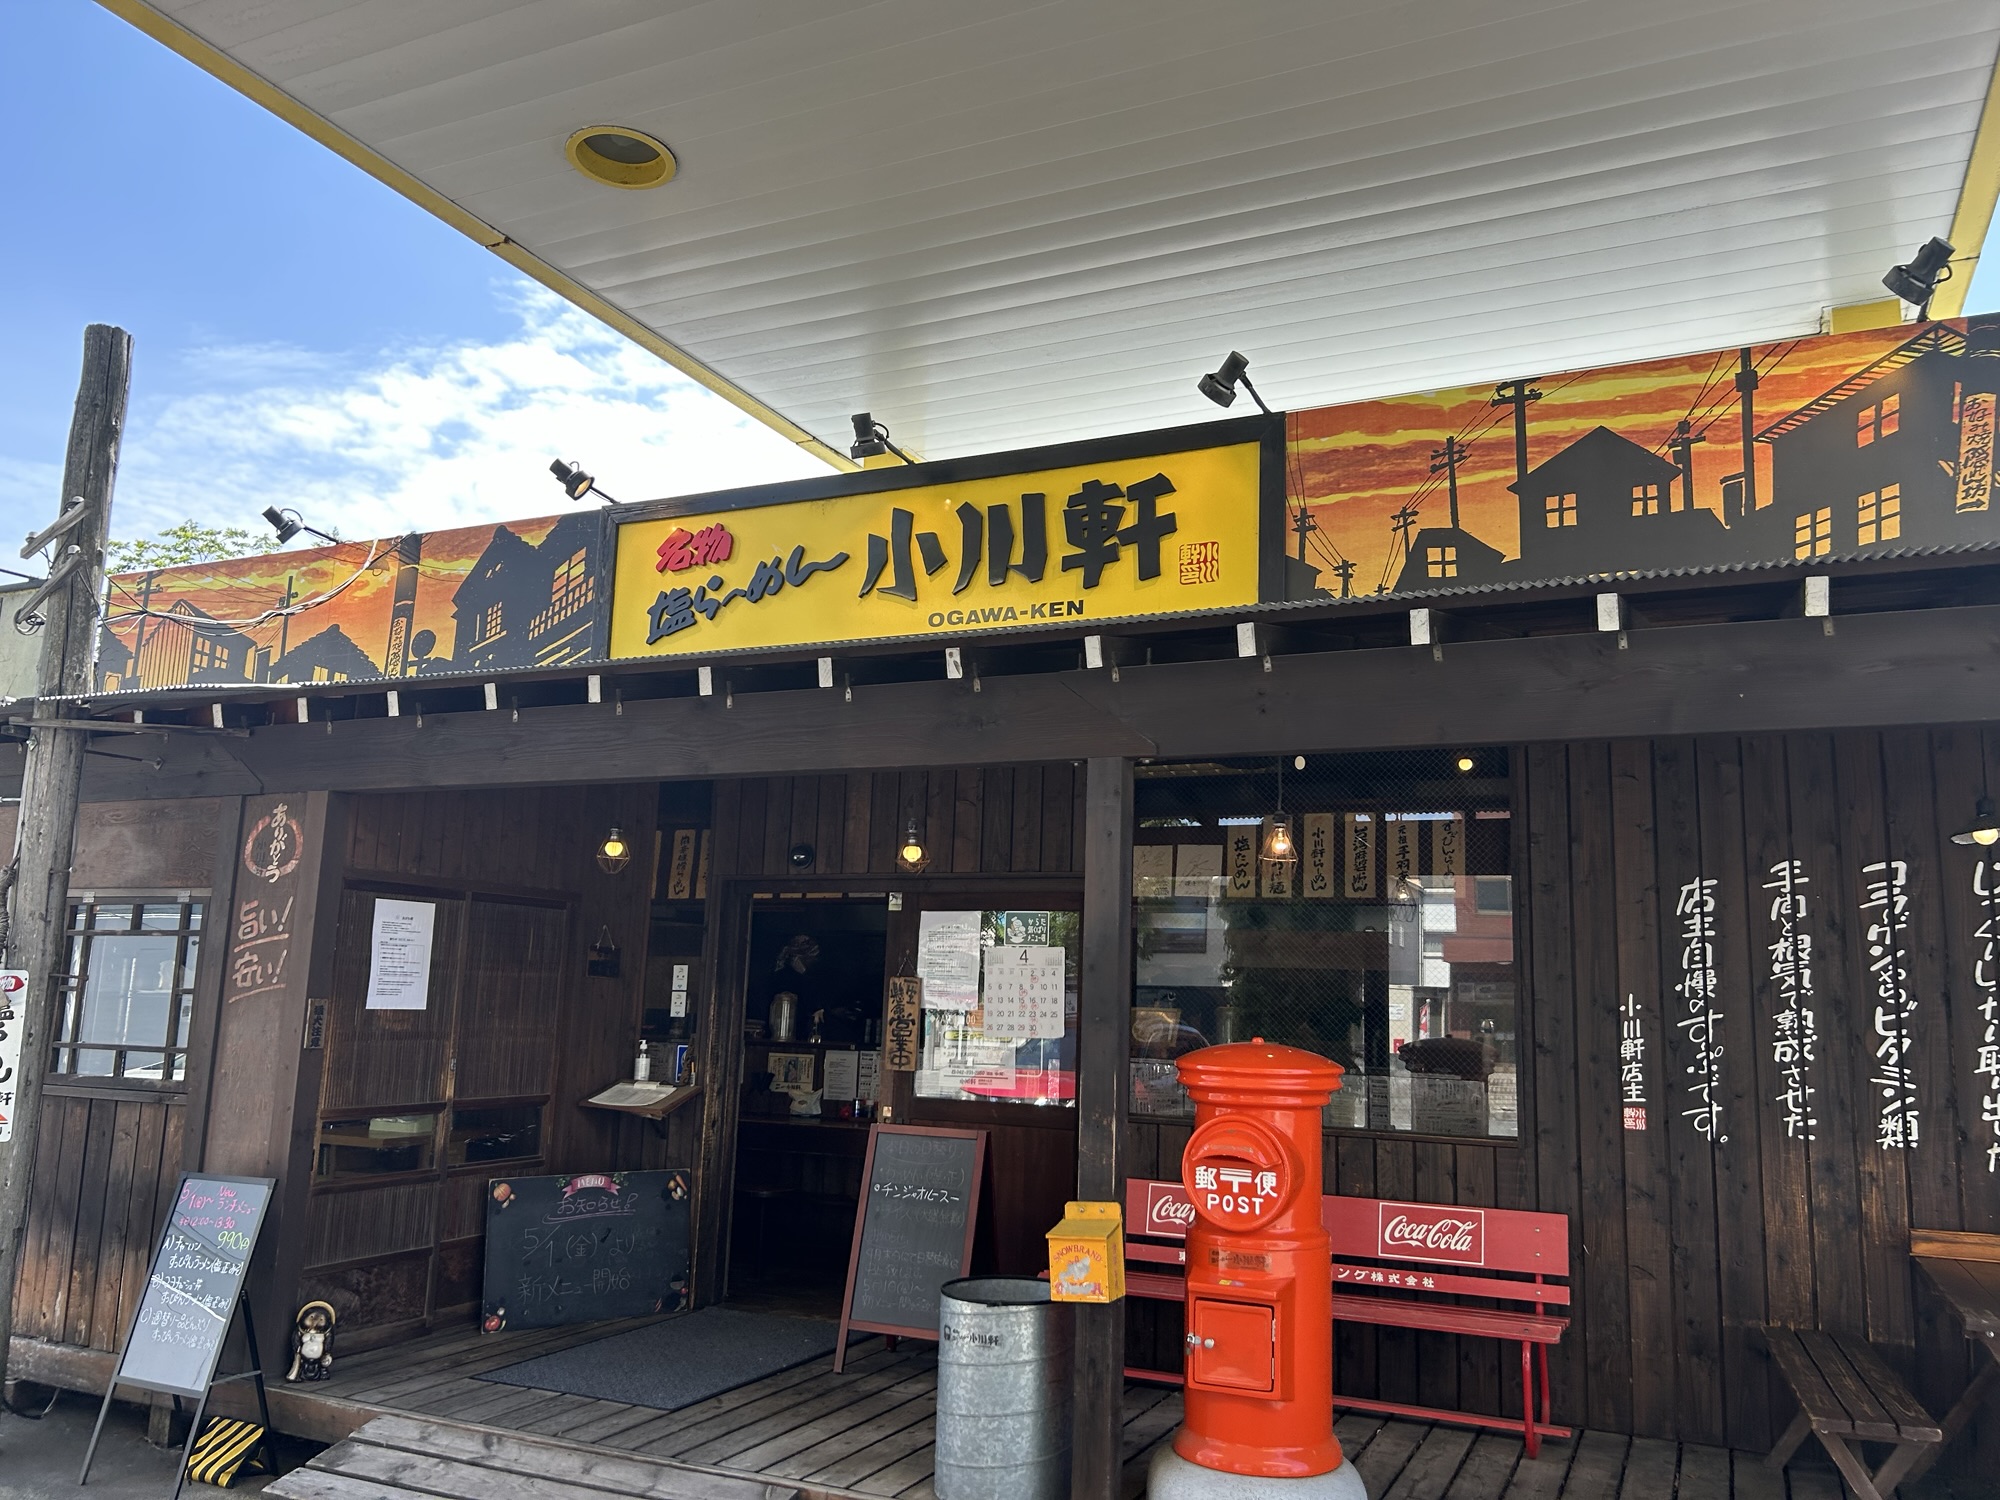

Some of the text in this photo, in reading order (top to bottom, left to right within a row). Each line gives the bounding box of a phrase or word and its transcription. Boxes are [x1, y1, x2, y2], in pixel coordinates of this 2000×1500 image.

[655, 523, 734, 574] 名物
[858, 472, 1177, 603] 小川軒
[927, 599, 1085, 628] OGAWA-KEN
[264, 803, 288, 883] ありがとう
[1232, 835, 1251, 890] 塩たんめん
[1019, 949, 1029, 964] 4
[888, 1012, 917, 1070] 営業中
[1619, 993, 1647, 1102] 小川軒店主
[218, 1186, 237, 1198] New
[577, 1177, 605, 1188] MENU
[217, 1197, 257, 1215] ランチメニュー
[1151, 1195, 1196, 1225] Coca
[1206, 1194, 1265, 1215] POST
[217, 1230, 251, 1250] 990円
[1383, 1214, 1478, 1252] Coca-Cola
[517, 1266, 631, 1304] 新メニュー開始
